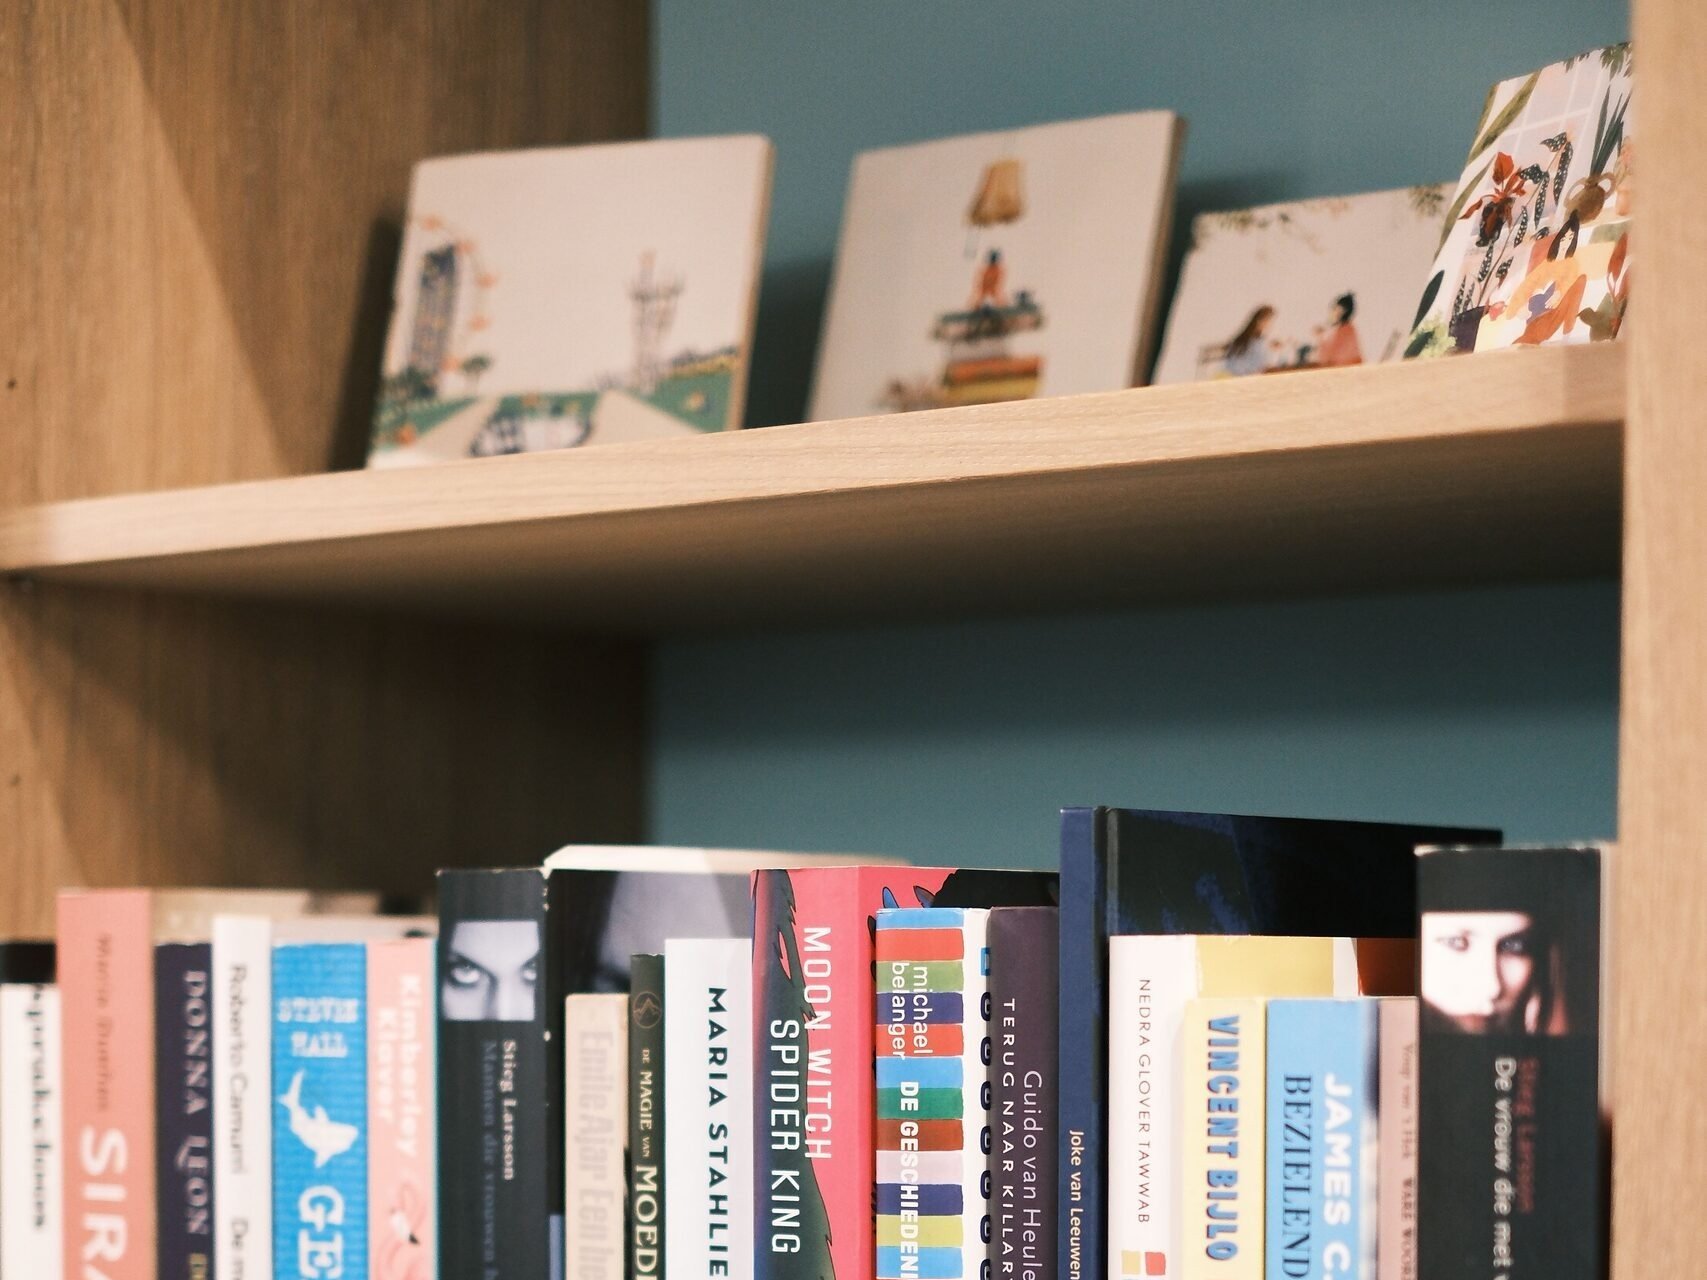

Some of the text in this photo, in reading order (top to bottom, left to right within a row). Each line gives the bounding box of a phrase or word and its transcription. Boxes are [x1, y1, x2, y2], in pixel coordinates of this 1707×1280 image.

[230, 964, 248, 1067] Roberto
[708, 987, 728, 1107] MARIA
[804, 927, 832, 1158] MOON WITCH
[887, 962, 910, 1059] belanger
[912, 966, 933, 1055] michael
[1002, 998, 1015, 1087] TERUG
[377, 1008, 399, 1123] Klaver
[394, 974, 421, 1157] Kimberley
[483, 1040, 497, 1126] Mannen
[641, 1048, 650, 1063] DE
[900, 1081, 919, 1110] DE
[1207, 1015, 1239, 1158] VINCENT
[1494, 1057, 1517, 1092] De
[176, 970, 209, 1234] DONNA LEON
[498, 1040, 517, 1180] Stieg Larsson
[639, 1071, 653, 1130] MAGIE
[770, 1020, 801, 1253] SPIDER KING
[1002, 1101, 1015, 1171] NAAR
[1023, 1070, 1043, 1148] Guido
[1137, 979, 1151, 1223] NEDRA GLOVER TAWWAB
[1493, 1098, 1514, 1172] vrouw
[1515, 1057, 1540, 1213] Stieg Larsson
[483, 1134, 497, 1164] die
[575, 1114, 614, 1181] Ajar
[641, 1137, 650, 1157] VAN
[1022, 1156, 1038, 1199] van
[1069, 1129, 1084, 1166] Joke
[1071, 1171, 1082, 1201] van
[1324, 1072, 1352, 1225] JAMES
[231, 1217, 248, 1249] De
[483, 1172, 497, 1261] vrouwen
[578, 1189, 614, 1241] Een
[708, 1123, 728, 1277] STAHLIE
[1206, 1170, 1238, 1261] BIJLO
[1401, 1176, 1414, 1221] WARE
[1493, 1178, 1517, 1214] die
[1070, 1207, 1084, 1280] Leeuwen
[1492, 1221, 1512, 1268] met
